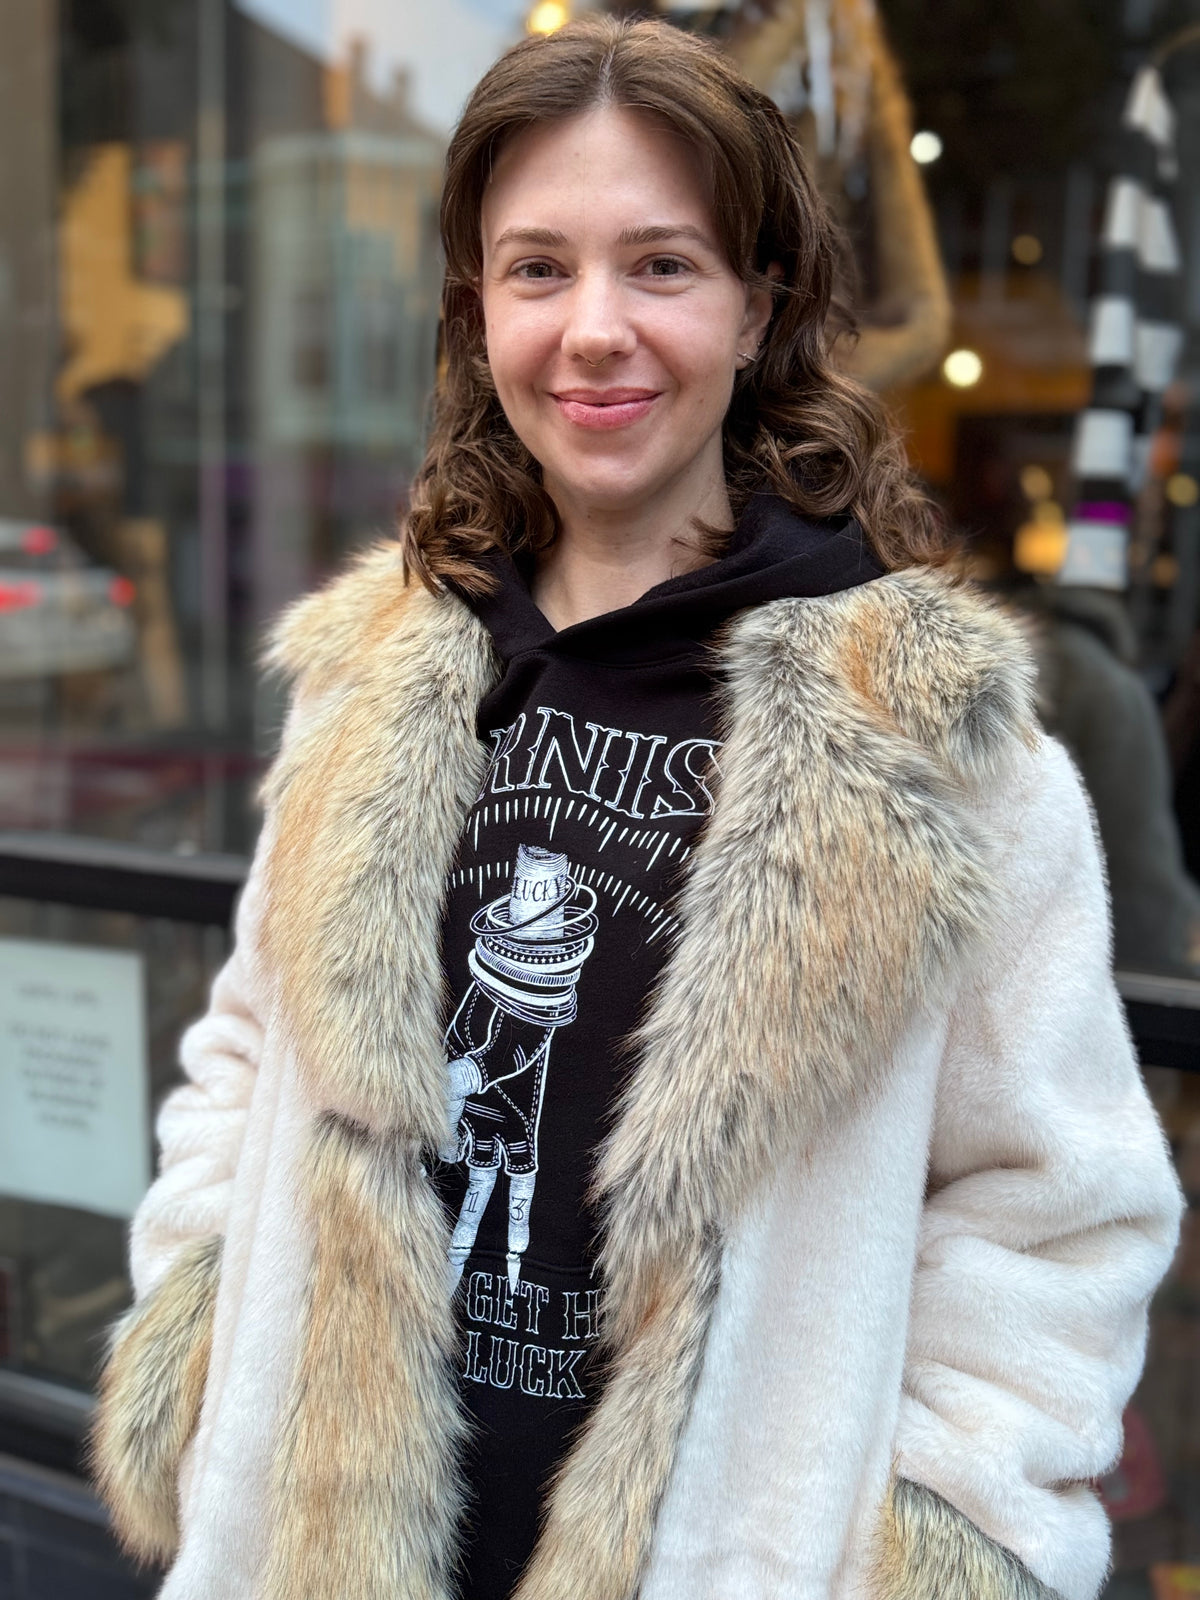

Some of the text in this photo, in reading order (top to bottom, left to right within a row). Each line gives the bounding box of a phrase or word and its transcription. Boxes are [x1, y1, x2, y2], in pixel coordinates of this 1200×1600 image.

[467, 1272, 608, 1339] GET H
[463, 1331, 587, 1398] LUCK
